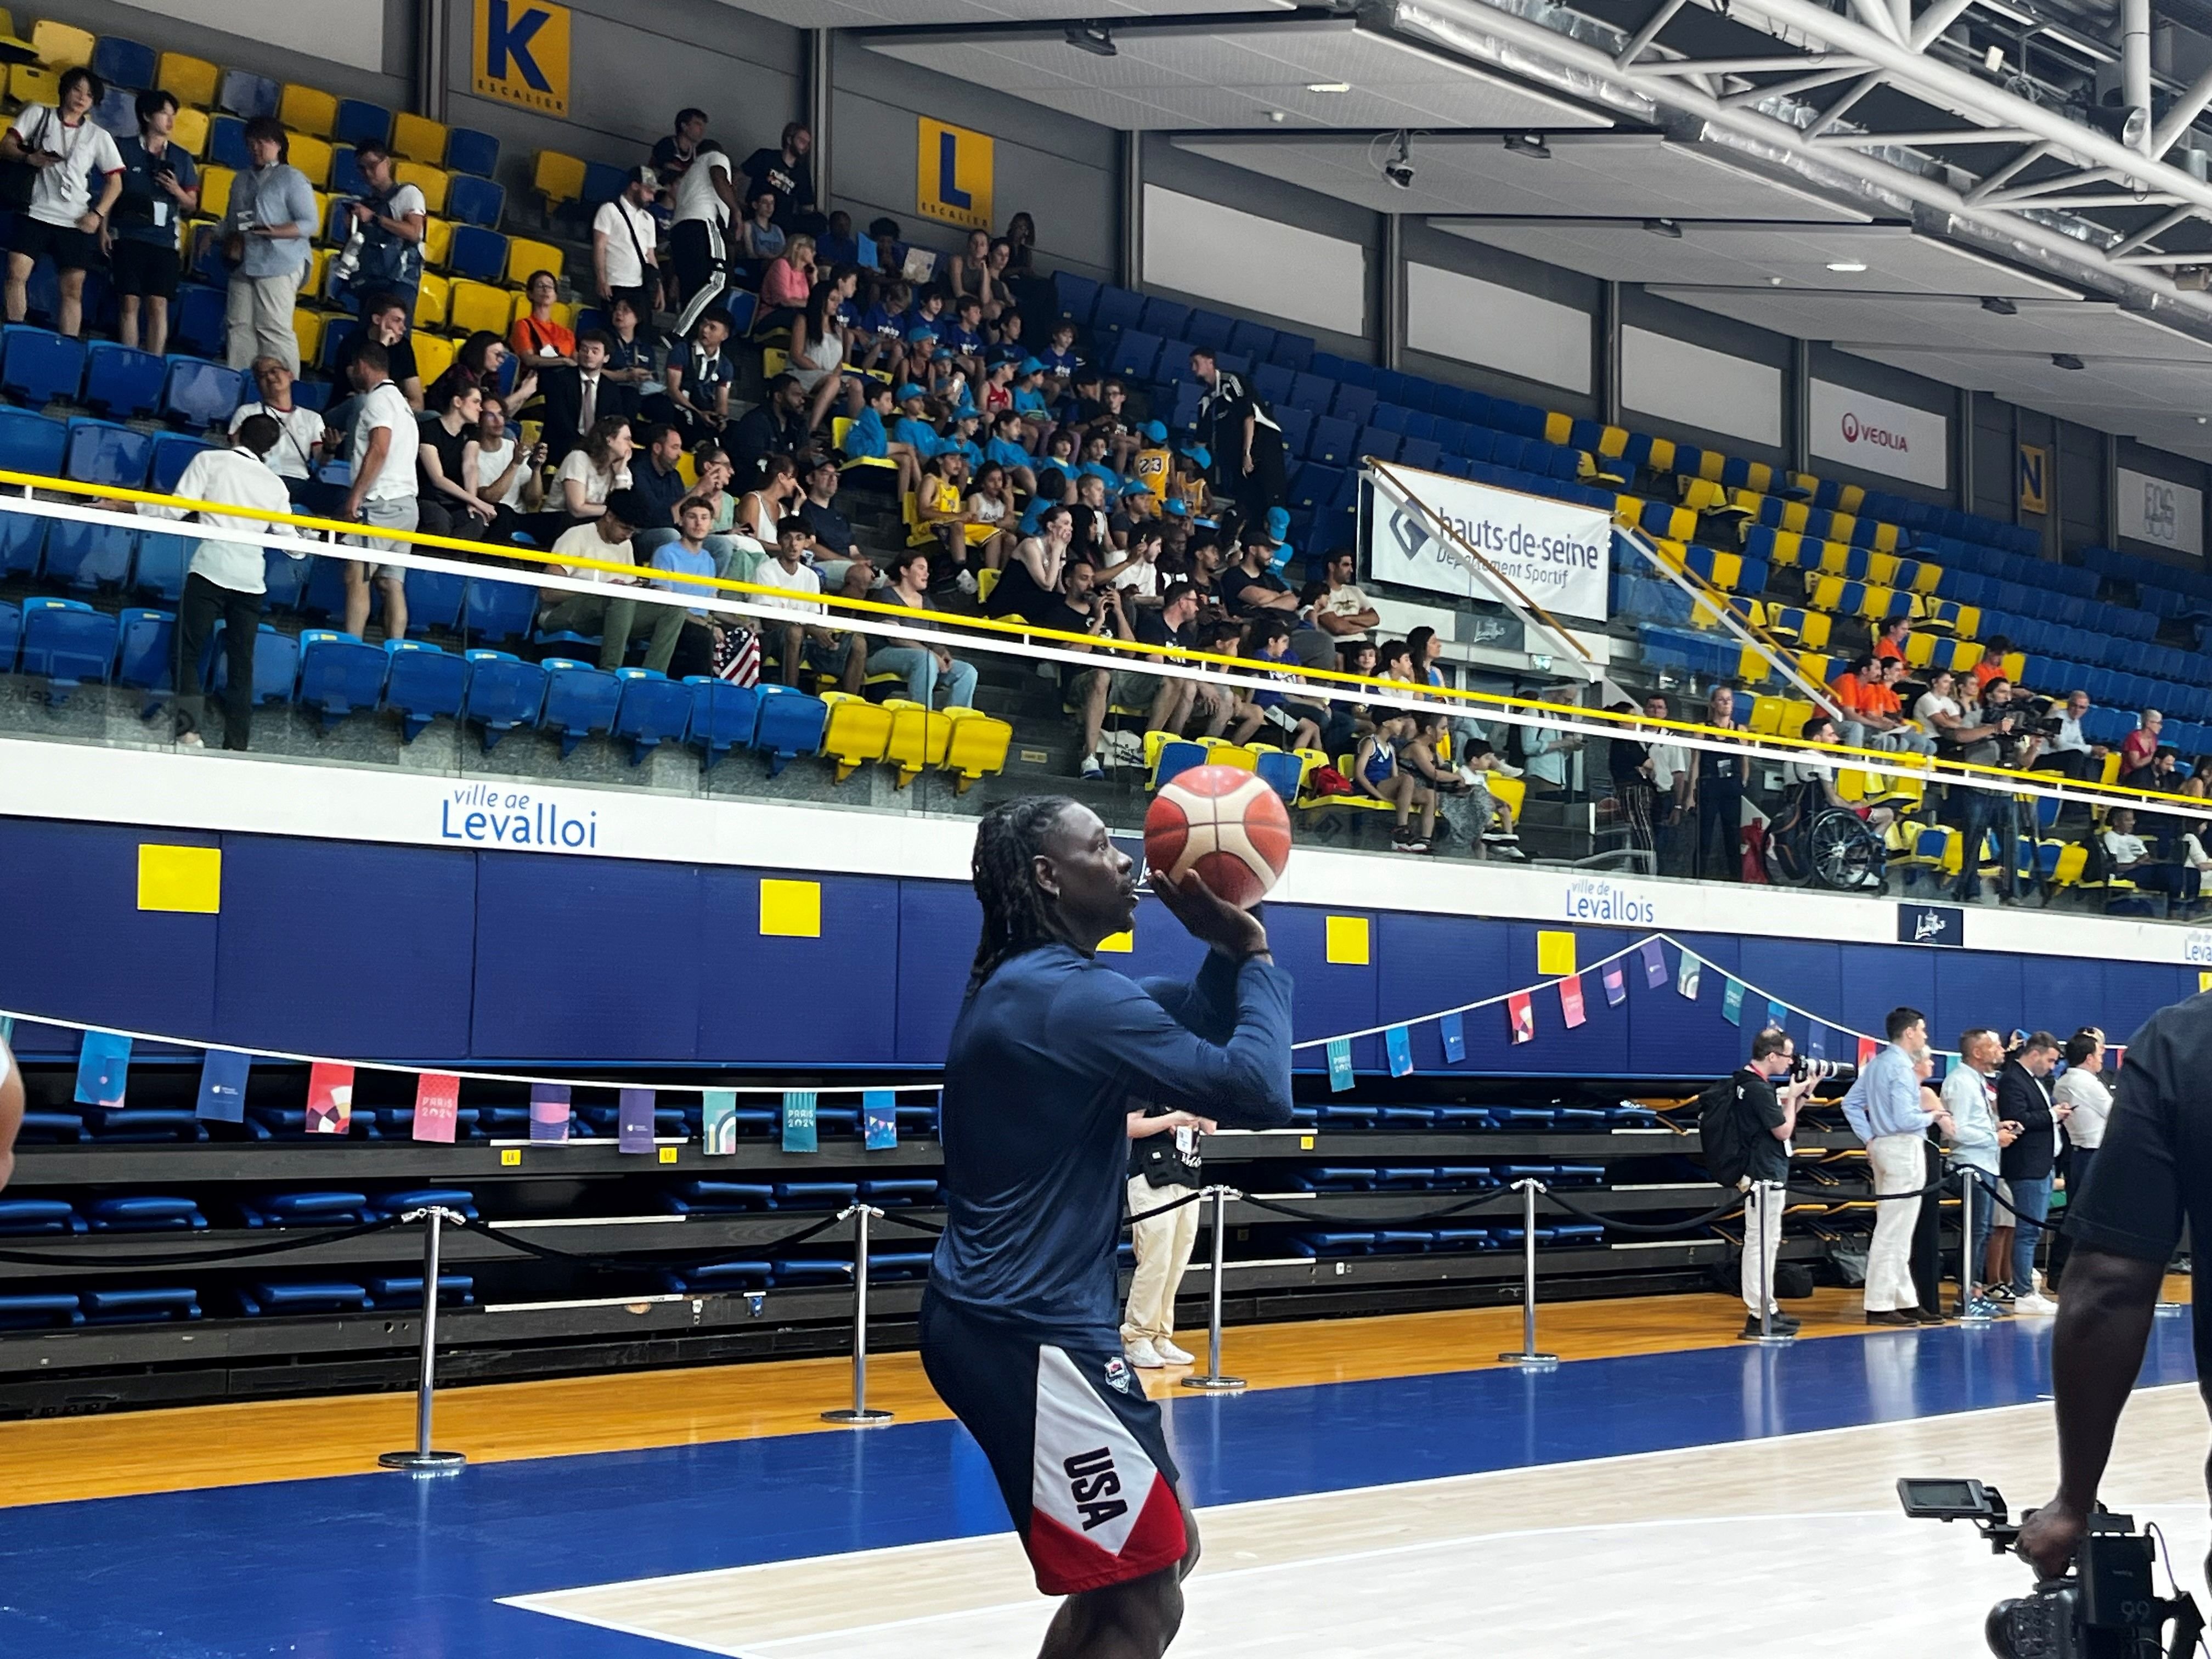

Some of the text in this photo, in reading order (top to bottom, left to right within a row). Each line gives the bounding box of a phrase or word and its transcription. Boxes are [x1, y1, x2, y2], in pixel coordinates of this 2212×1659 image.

[487, 0, 552, 93] K
[477, 79, 562, 110] ESCALIER
[939, 131, 970, 210] L
[1861, 425, 1908, 453] VEOLIA
[1139, 458, 1163, 473] 23
[2021, 450, 2041, 500] N
[1524, 563, 1568, 589] Sportif
[454, 784, 498, 808] ville
[1571, 878, 1610, 896] ville de
[1566, 889, 1654, 923] Levallois
[787, 1119, 814, 1127] 2024
[788, 1109, 814, 1118] PARIS
[1063, 1446, 1128, 1531] USA
